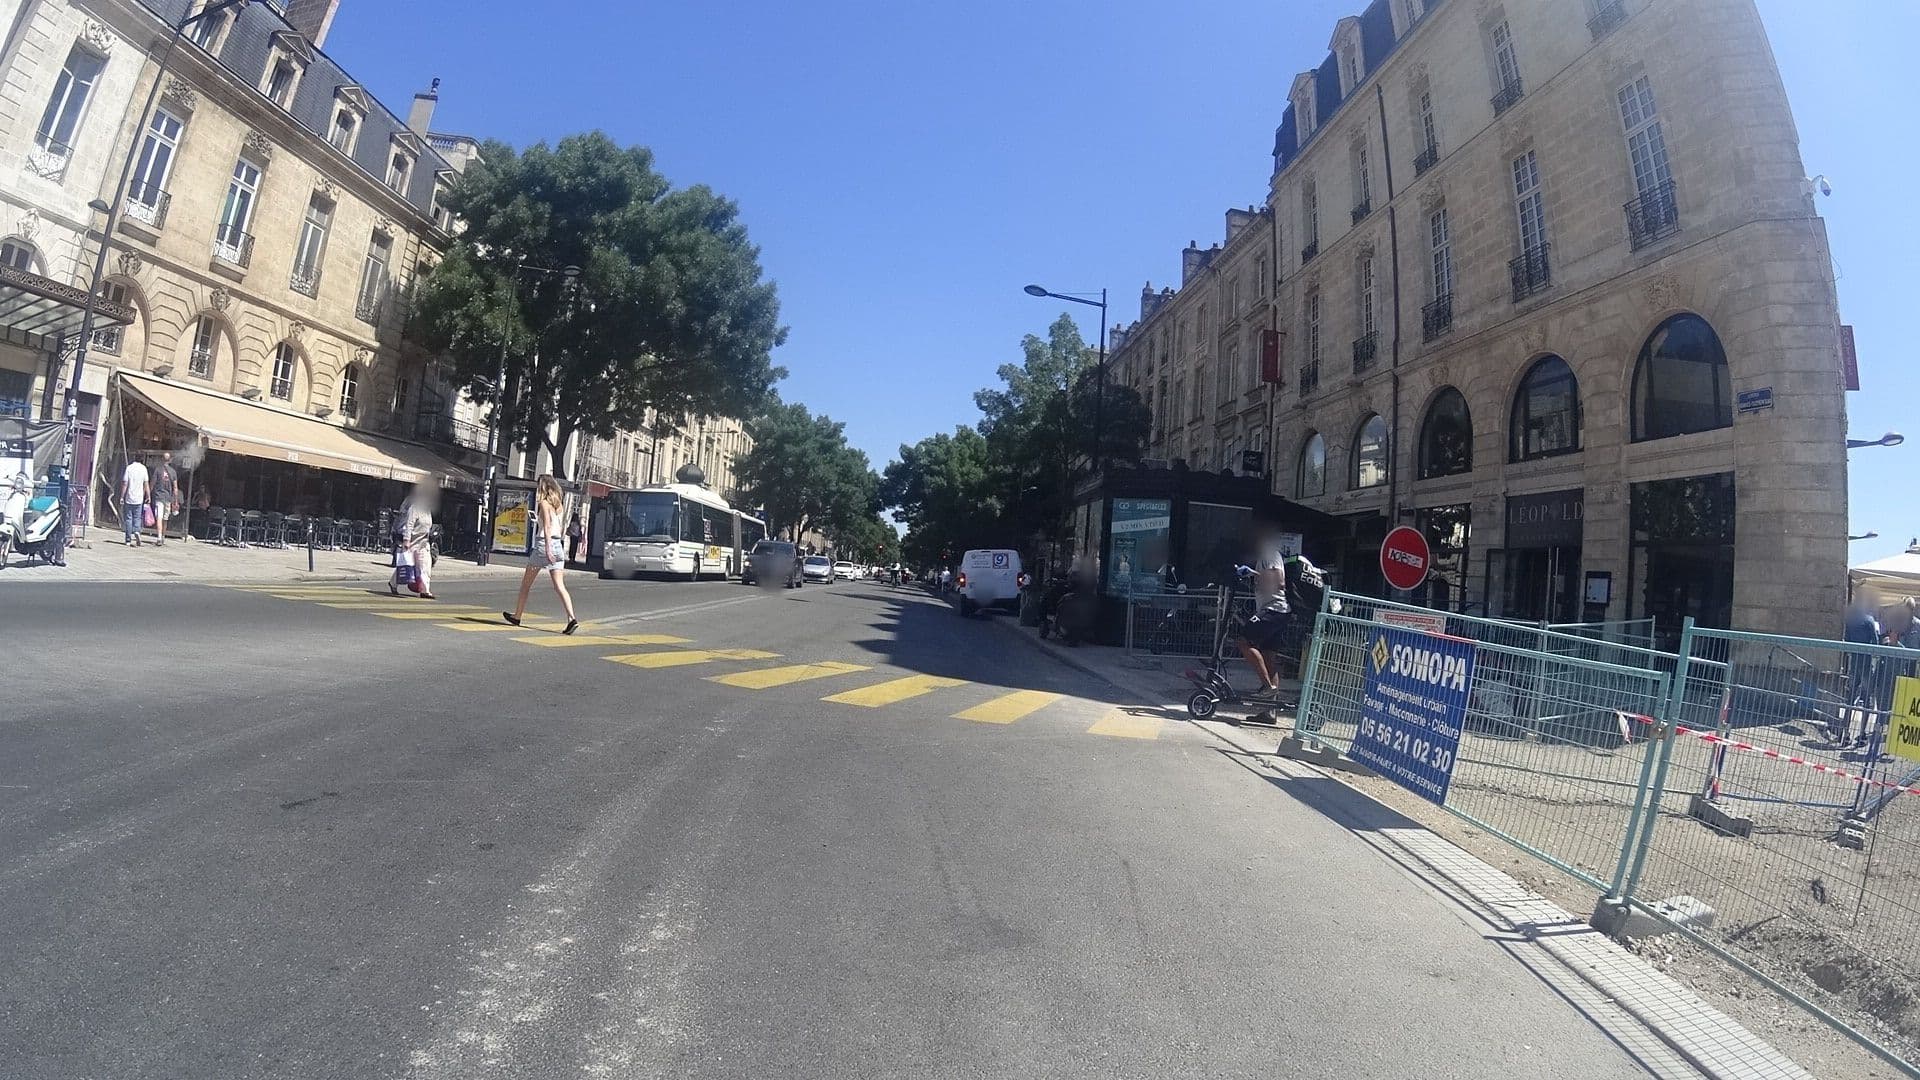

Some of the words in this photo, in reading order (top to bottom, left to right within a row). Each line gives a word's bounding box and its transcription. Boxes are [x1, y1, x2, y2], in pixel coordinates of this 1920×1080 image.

[1510, 501, 1584, 524] LÉOPLD
[1300, 572, 1324, 588] Eats
[1390, 643, 1466, 692] SOMOPA
[1431, 718, 1460, 739] Clôture
[1361, 716, 1376, 738] 05
[1376, 723, 1392, 746] 56
[1393, 730, 1410, 754] 21
[1412, 738, 1430, 763] 02
[1431, 746, 1452, 773] 30
[1397, 765, 1416, 782] VOTRE
[1415, 774, 1443, 795] SERVICE
